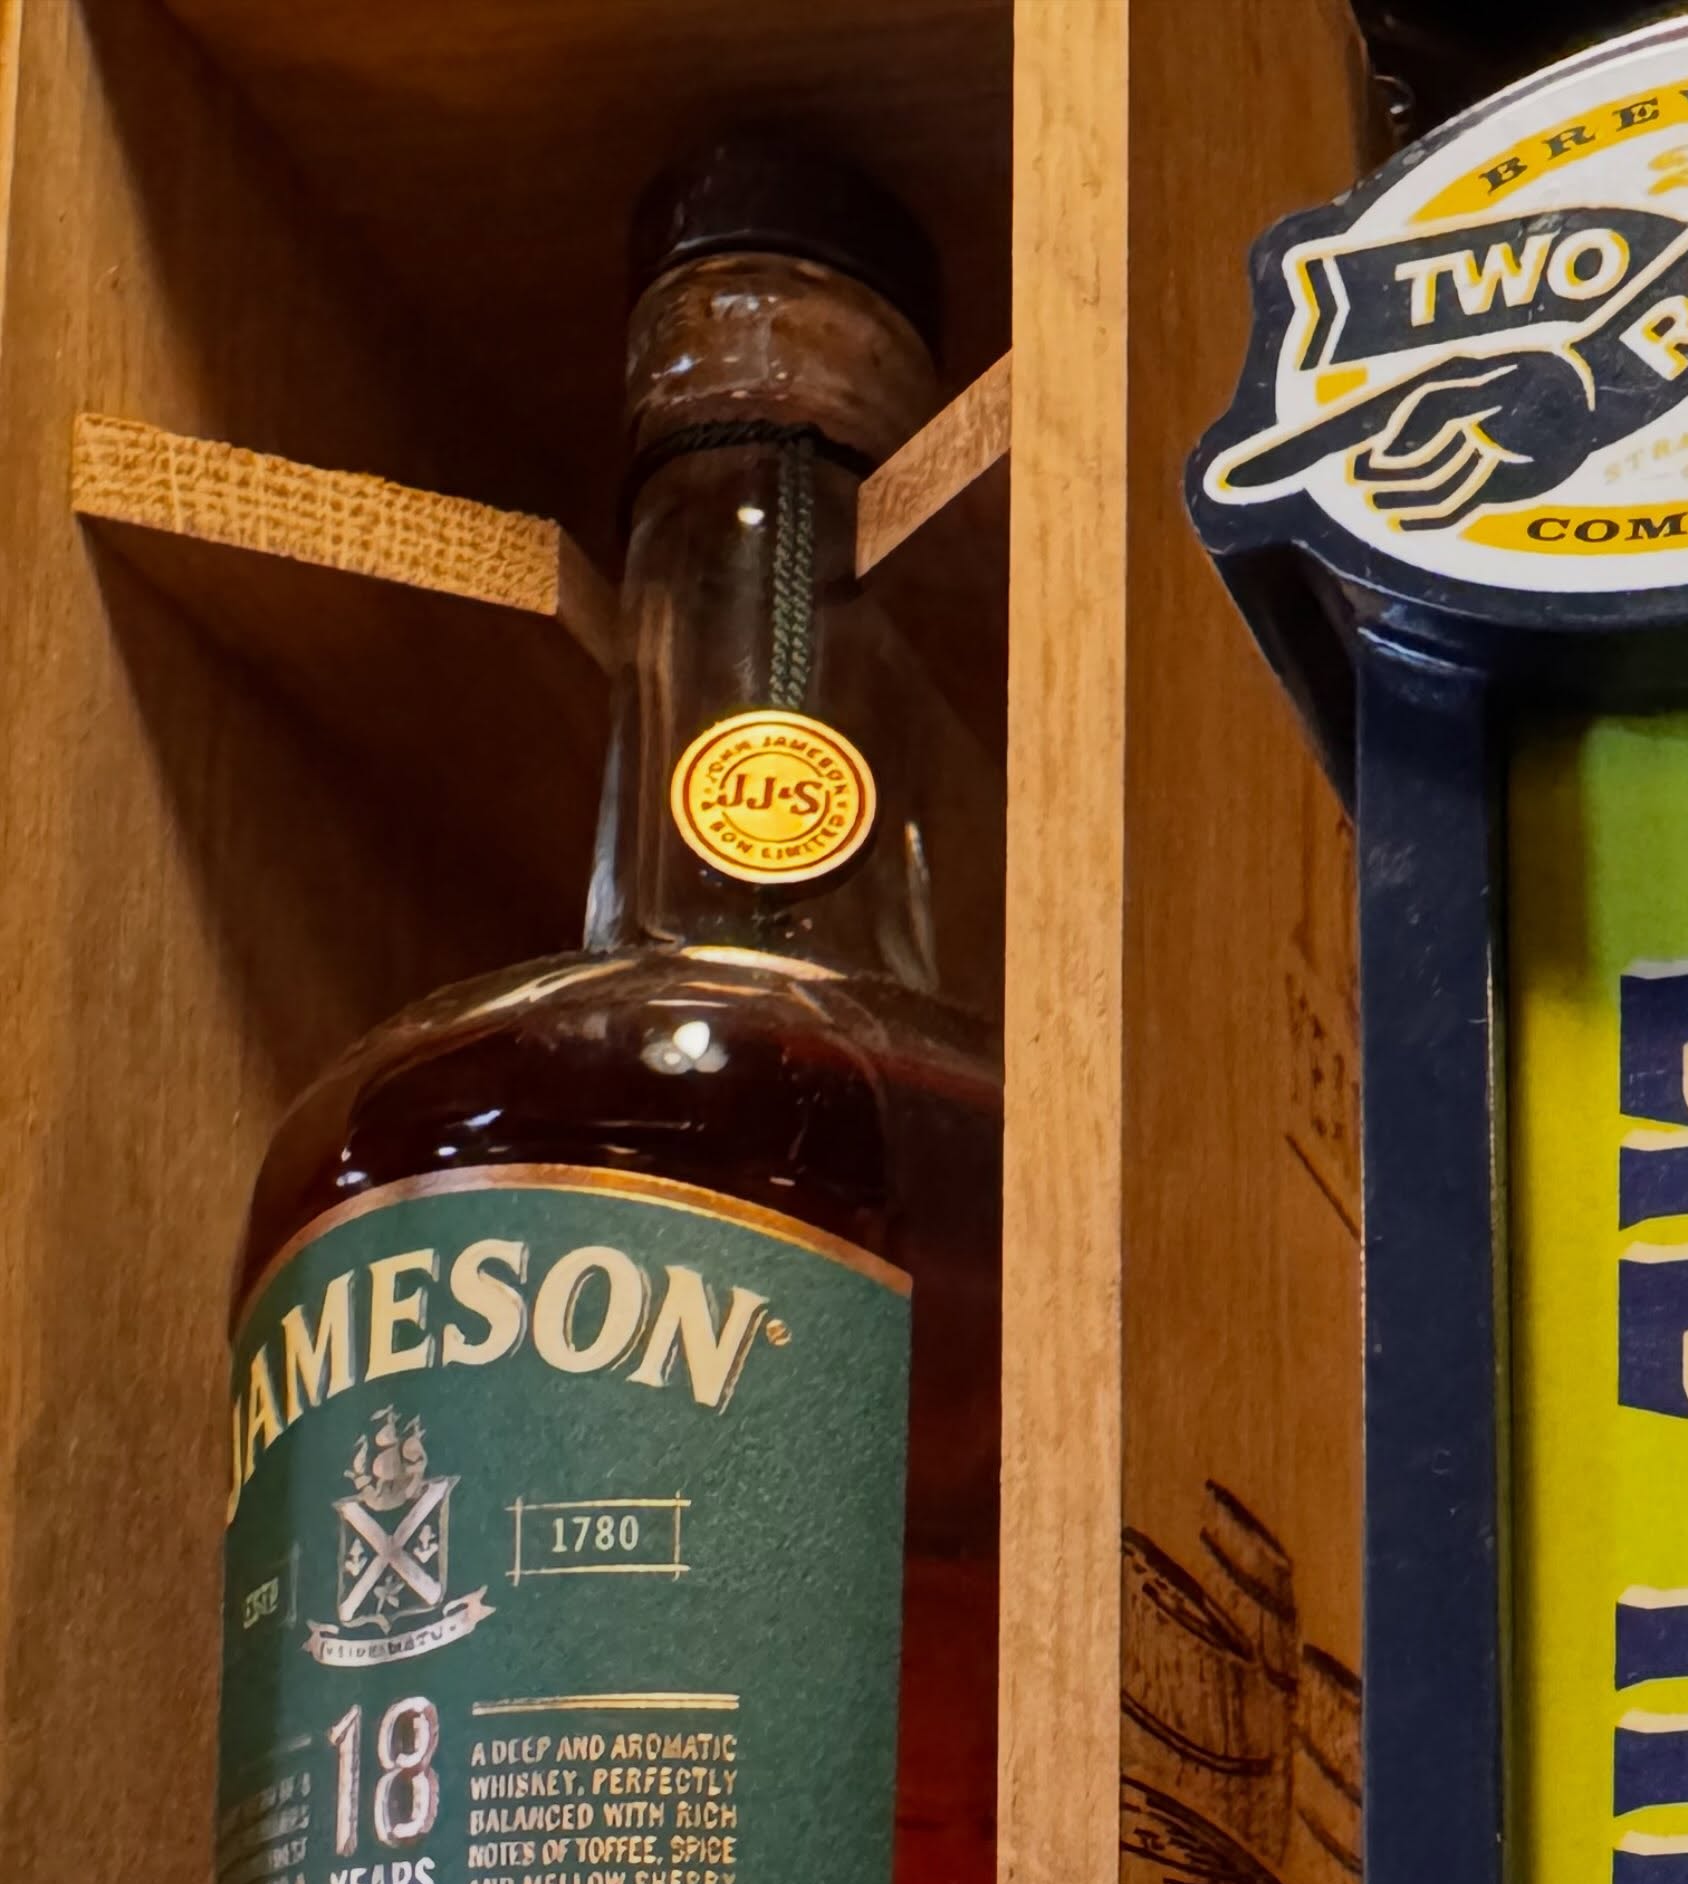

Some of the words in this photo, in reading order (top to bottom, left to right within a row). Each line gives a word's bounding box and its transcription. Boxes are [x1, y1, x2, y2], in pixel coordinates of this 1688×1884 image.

[1394, 227, 1631, 329] TWO
[226, 1239, 769, 1525] JAMESON
[551, 1513, 641, 1553] 1780
[471, 1741, 487, 1768] A
[491, 1735, 551, 1766] DEEP
[556, 1733, 606, 1763] AND
[610, 1731, 738, 1762] AROMATIC
[328, 1696, 440, 1857] 18
[591, 1766, 738, 1797] PERFECTLY
[469, 1802, 595, 1837] BALANCED
[603, 1800, 665, 1830] WITH
[675, 1799, 738, 1831] RICH
[467, 1840, 537, 1869] NOTES
[541, 1837, 571, 1866] OF
[670, 1833, 737, 1864] SPICE
